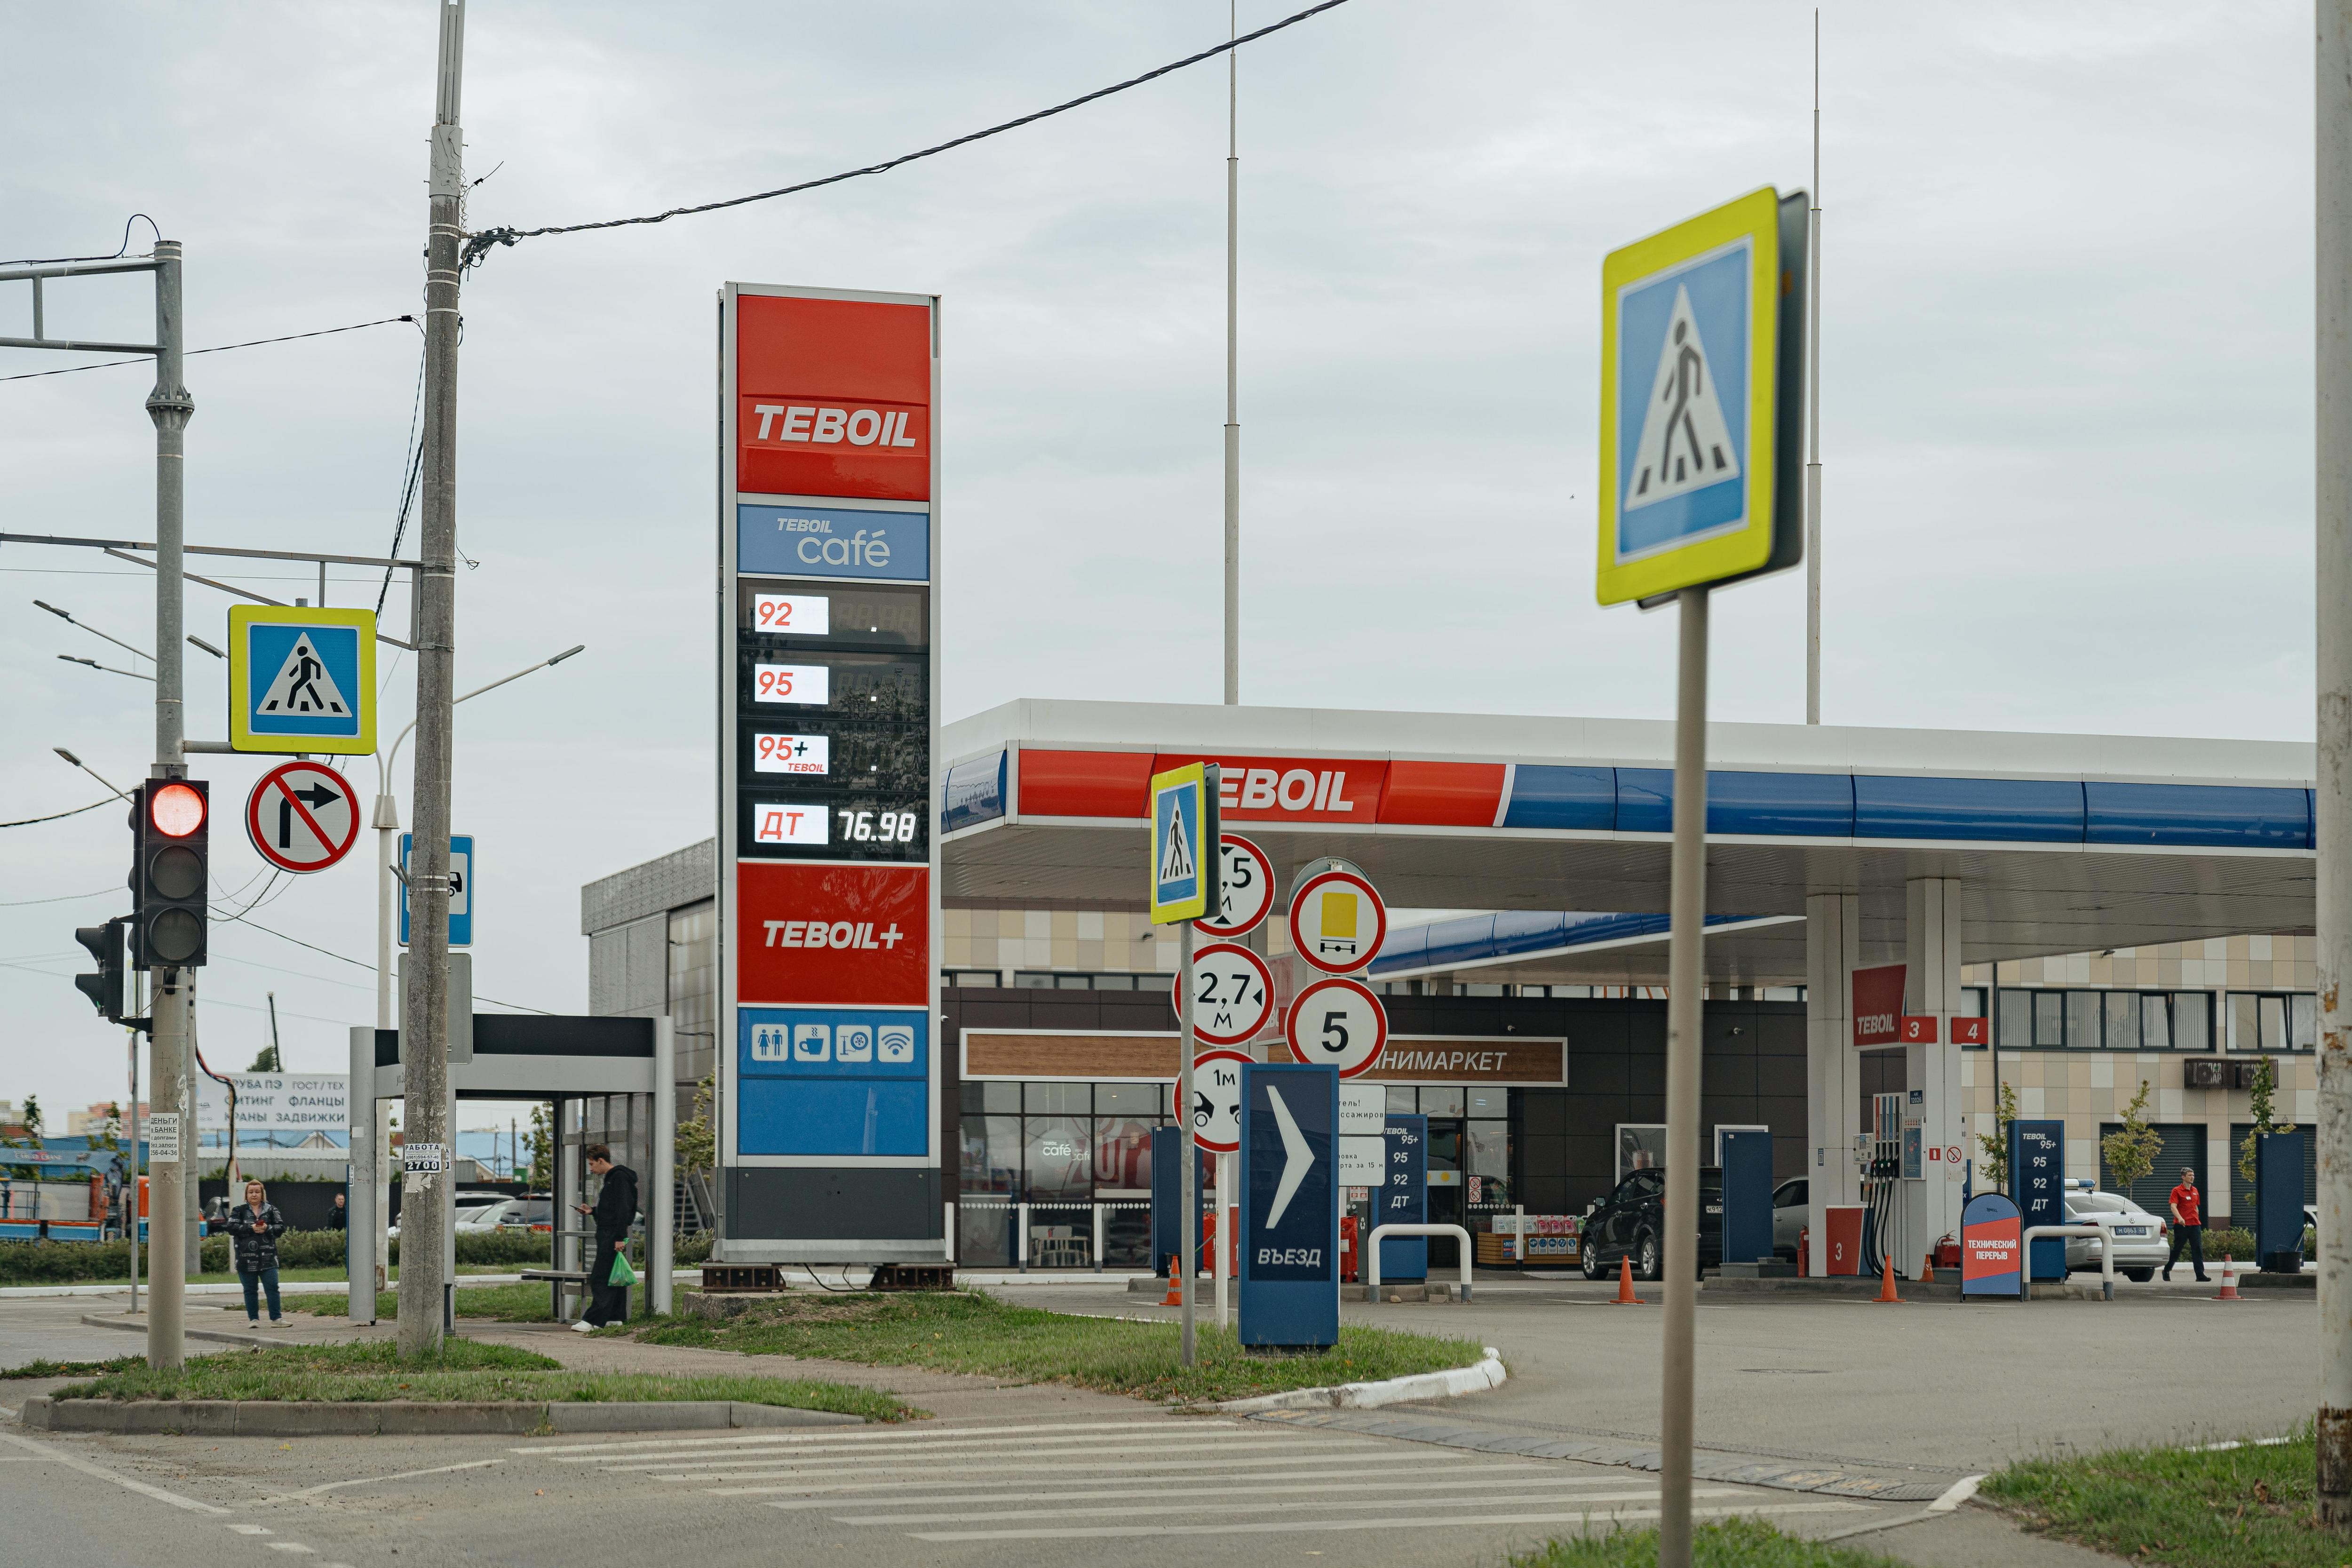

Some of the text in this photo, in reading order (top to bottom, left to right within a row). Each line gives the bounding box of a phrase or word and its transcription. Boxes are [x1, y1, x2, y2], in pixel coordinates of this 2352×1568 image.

[754, 404, 916, 448] TEBOIL
[777, 518, 833, 533] TEBOIL
[797, 529, 891, 567] café
[759, 602, 792, 626] 92
[759, 671, 794, 695] 95
[759, 736, 808, 761] 95+
[788, 763, 825, 772] TEBOIL
[1220, 767, 1354, 812] EBOIL
[759, 811, 916, 843] ДТ 76.98
[1222, 857, 1252, 892] ,5
[763, 920, 904, 950] TEBOIL+
[1198, 972, 1251, 1009] 2,7
[1321, 1011, 1350, 1052] 5
[1857, 1013, 1895, 1035] TEBOIL
[1909, 1021, 1920, 1038] 3
[1968, 1023, 1978, 1039] 4
[1375, 1051, 1507, 1071] НИМАРКЕТ
[232, 1079, 262, 1089] РУБА
[292, 1081, 319, 1090] ГОСТ
[288, 1095, 344, 1106] ФЛАНЦЫ
[276, 1112, 345, 1122] ЗАДВИЖКИ
[1401, 1135, 1418, 1144] 95+
[2040, 1140, 2057, 1149] 95+
[1042, 1144, 1072, 1156] café
[1393, 1152, 1408, 1163] 95
[408, 1162, 437, 1170] 2700
[2033, 1156, 2047, 1167] 95
[1393, 1174, 1408, 1185] 92
[2033, 1178, 2047, 1188] 92
[1391, 1196, 1409, 1208] ДТ
[2032, 1199, 2049, 1211] ДТ
[1836, 1242, 1842, 1261] 3
[1968, 1239, 2017, 1249] ТЕХНИЧЕСКИЙ
[1258, 1248, 1321, 1268] ВЪЕЗД
[1976, 1251, 2008, 1260] ПЕРЕРЫВ
